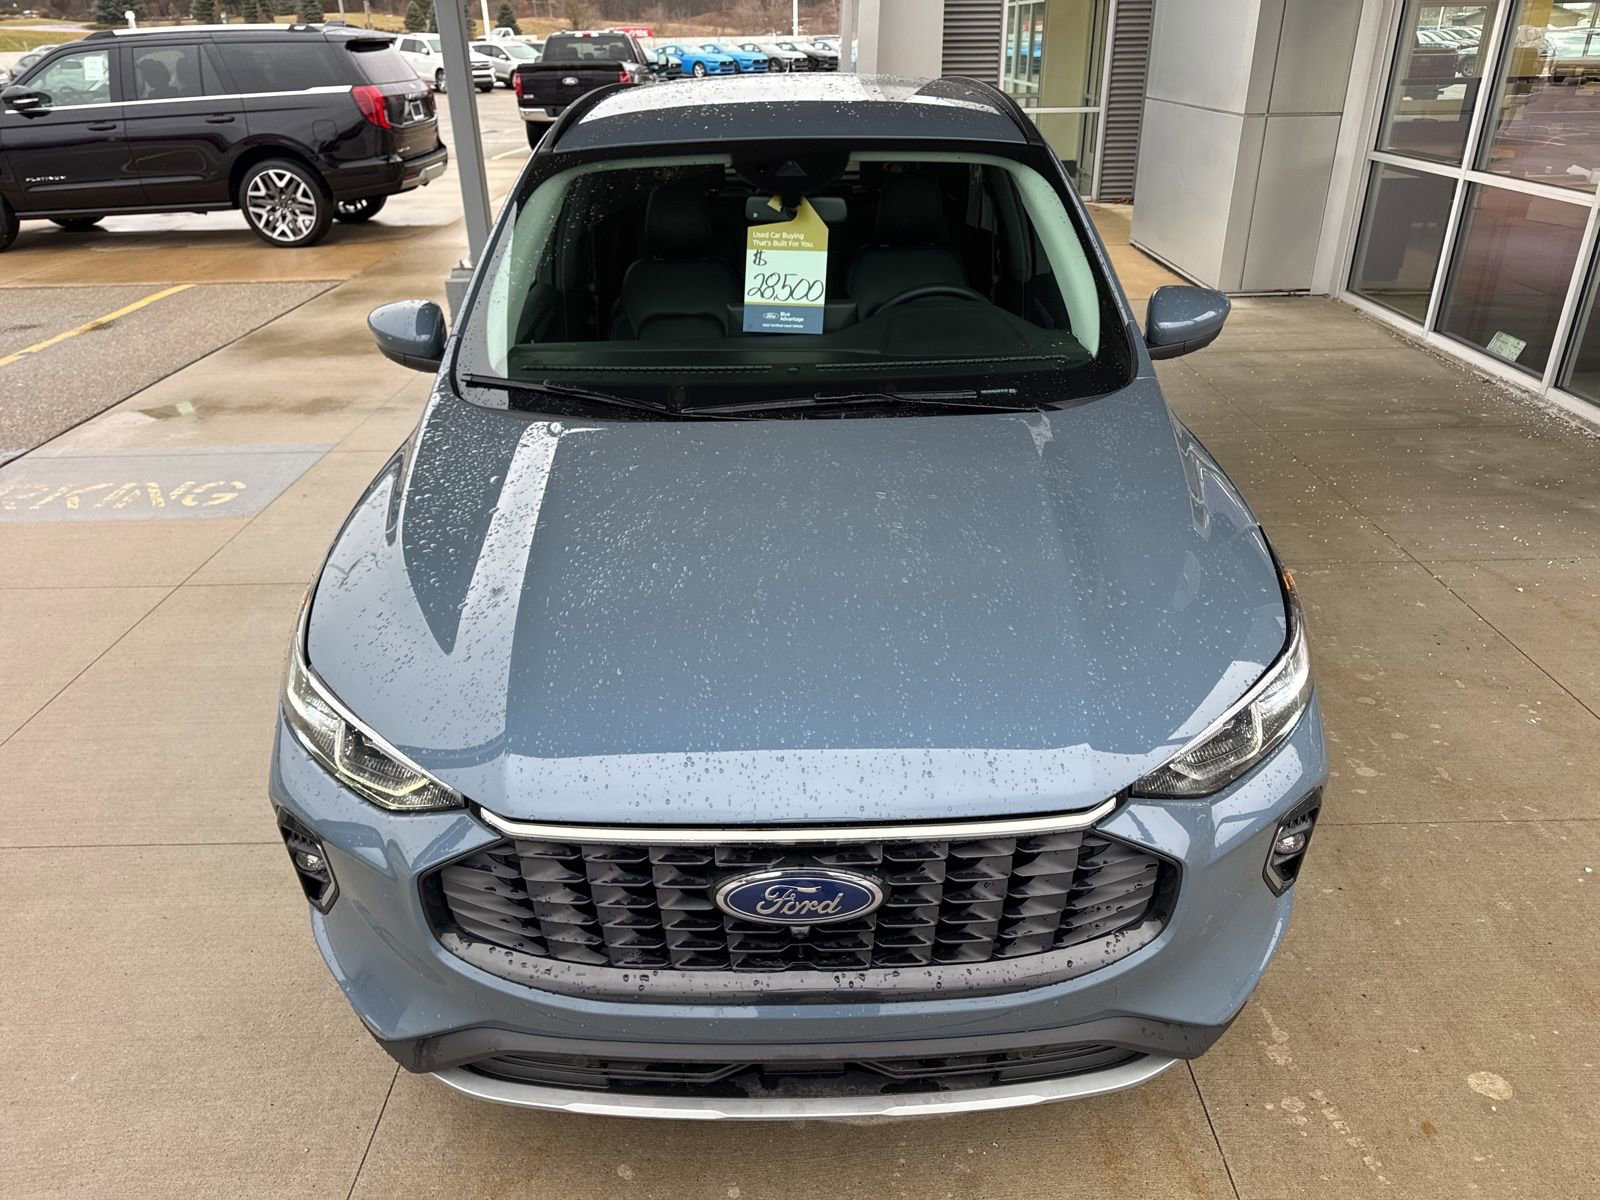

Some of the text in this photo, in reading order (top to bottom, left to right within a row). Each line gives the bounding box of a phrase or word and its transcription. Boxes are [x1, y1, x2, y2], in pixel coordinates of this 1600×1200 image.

[782, 232, 804, 240] Buying
[753, 249, 768, 266] $
[747, 272, 824, 302] 28,500
[756, 884, 844, 915] Ford
